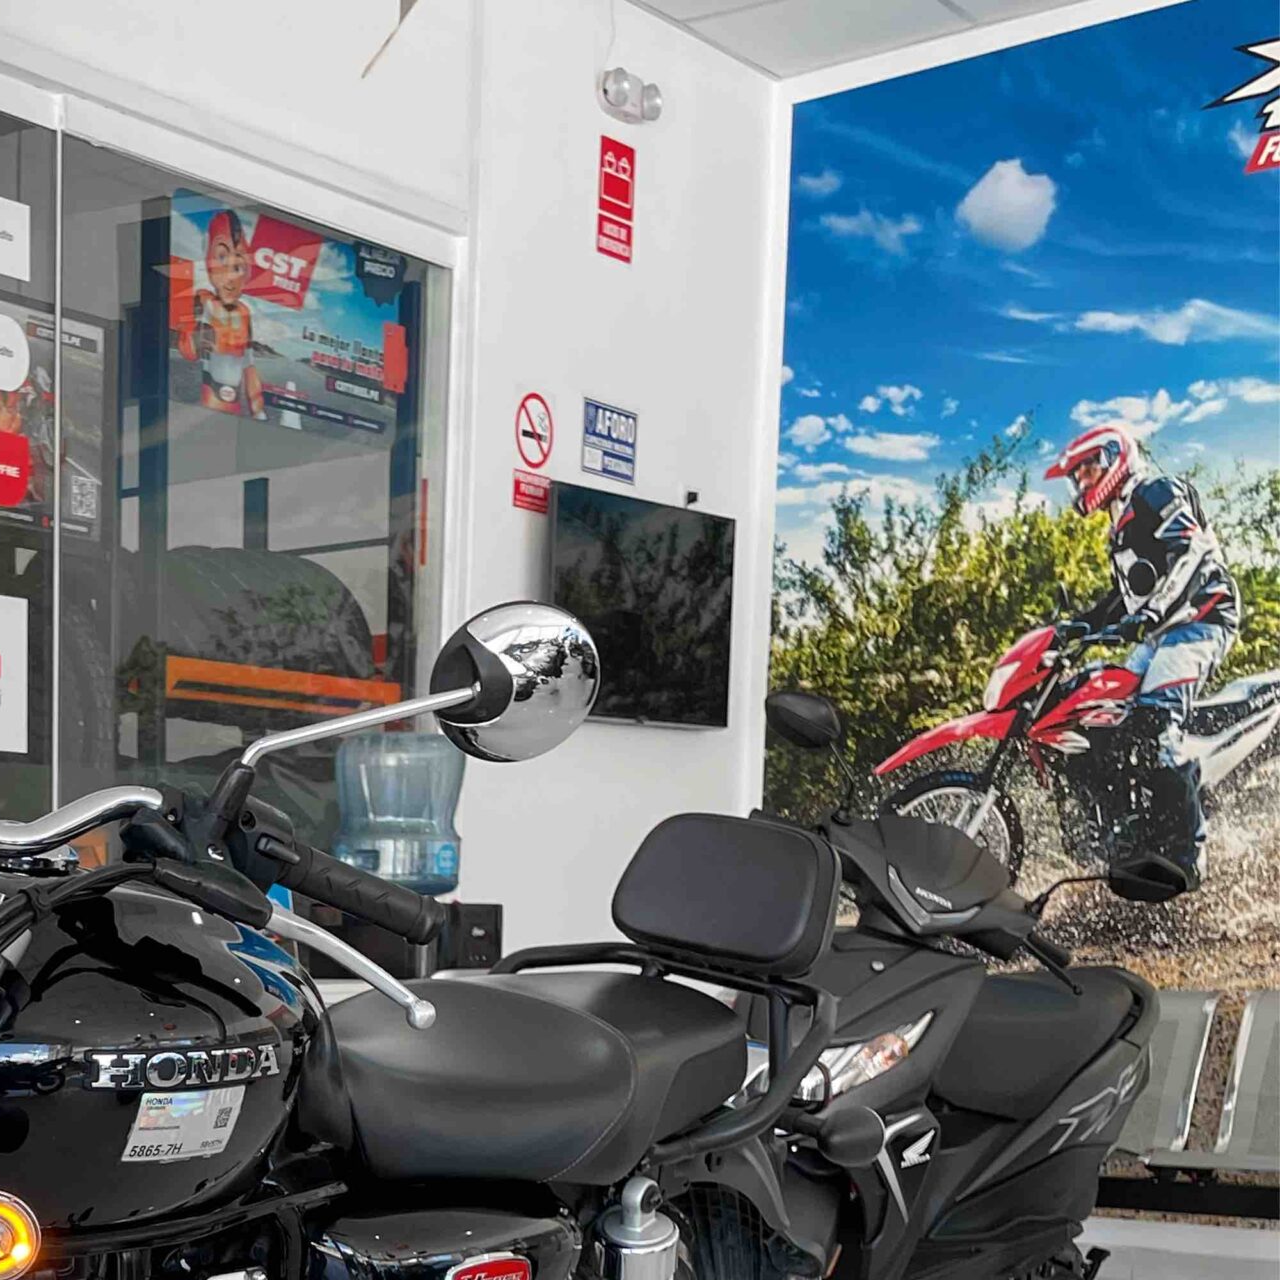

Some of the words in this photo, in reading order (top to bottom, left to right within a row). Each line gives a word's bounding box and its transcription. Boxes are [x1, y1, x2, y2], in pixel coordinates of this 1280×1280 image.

[255, 247, 308, 279] CST
[90, 1043, 282, 1089] HONDA
[146, 1096, 174, 1107] HONDA
[128, 1142, 183, 1158] 5865-7H
